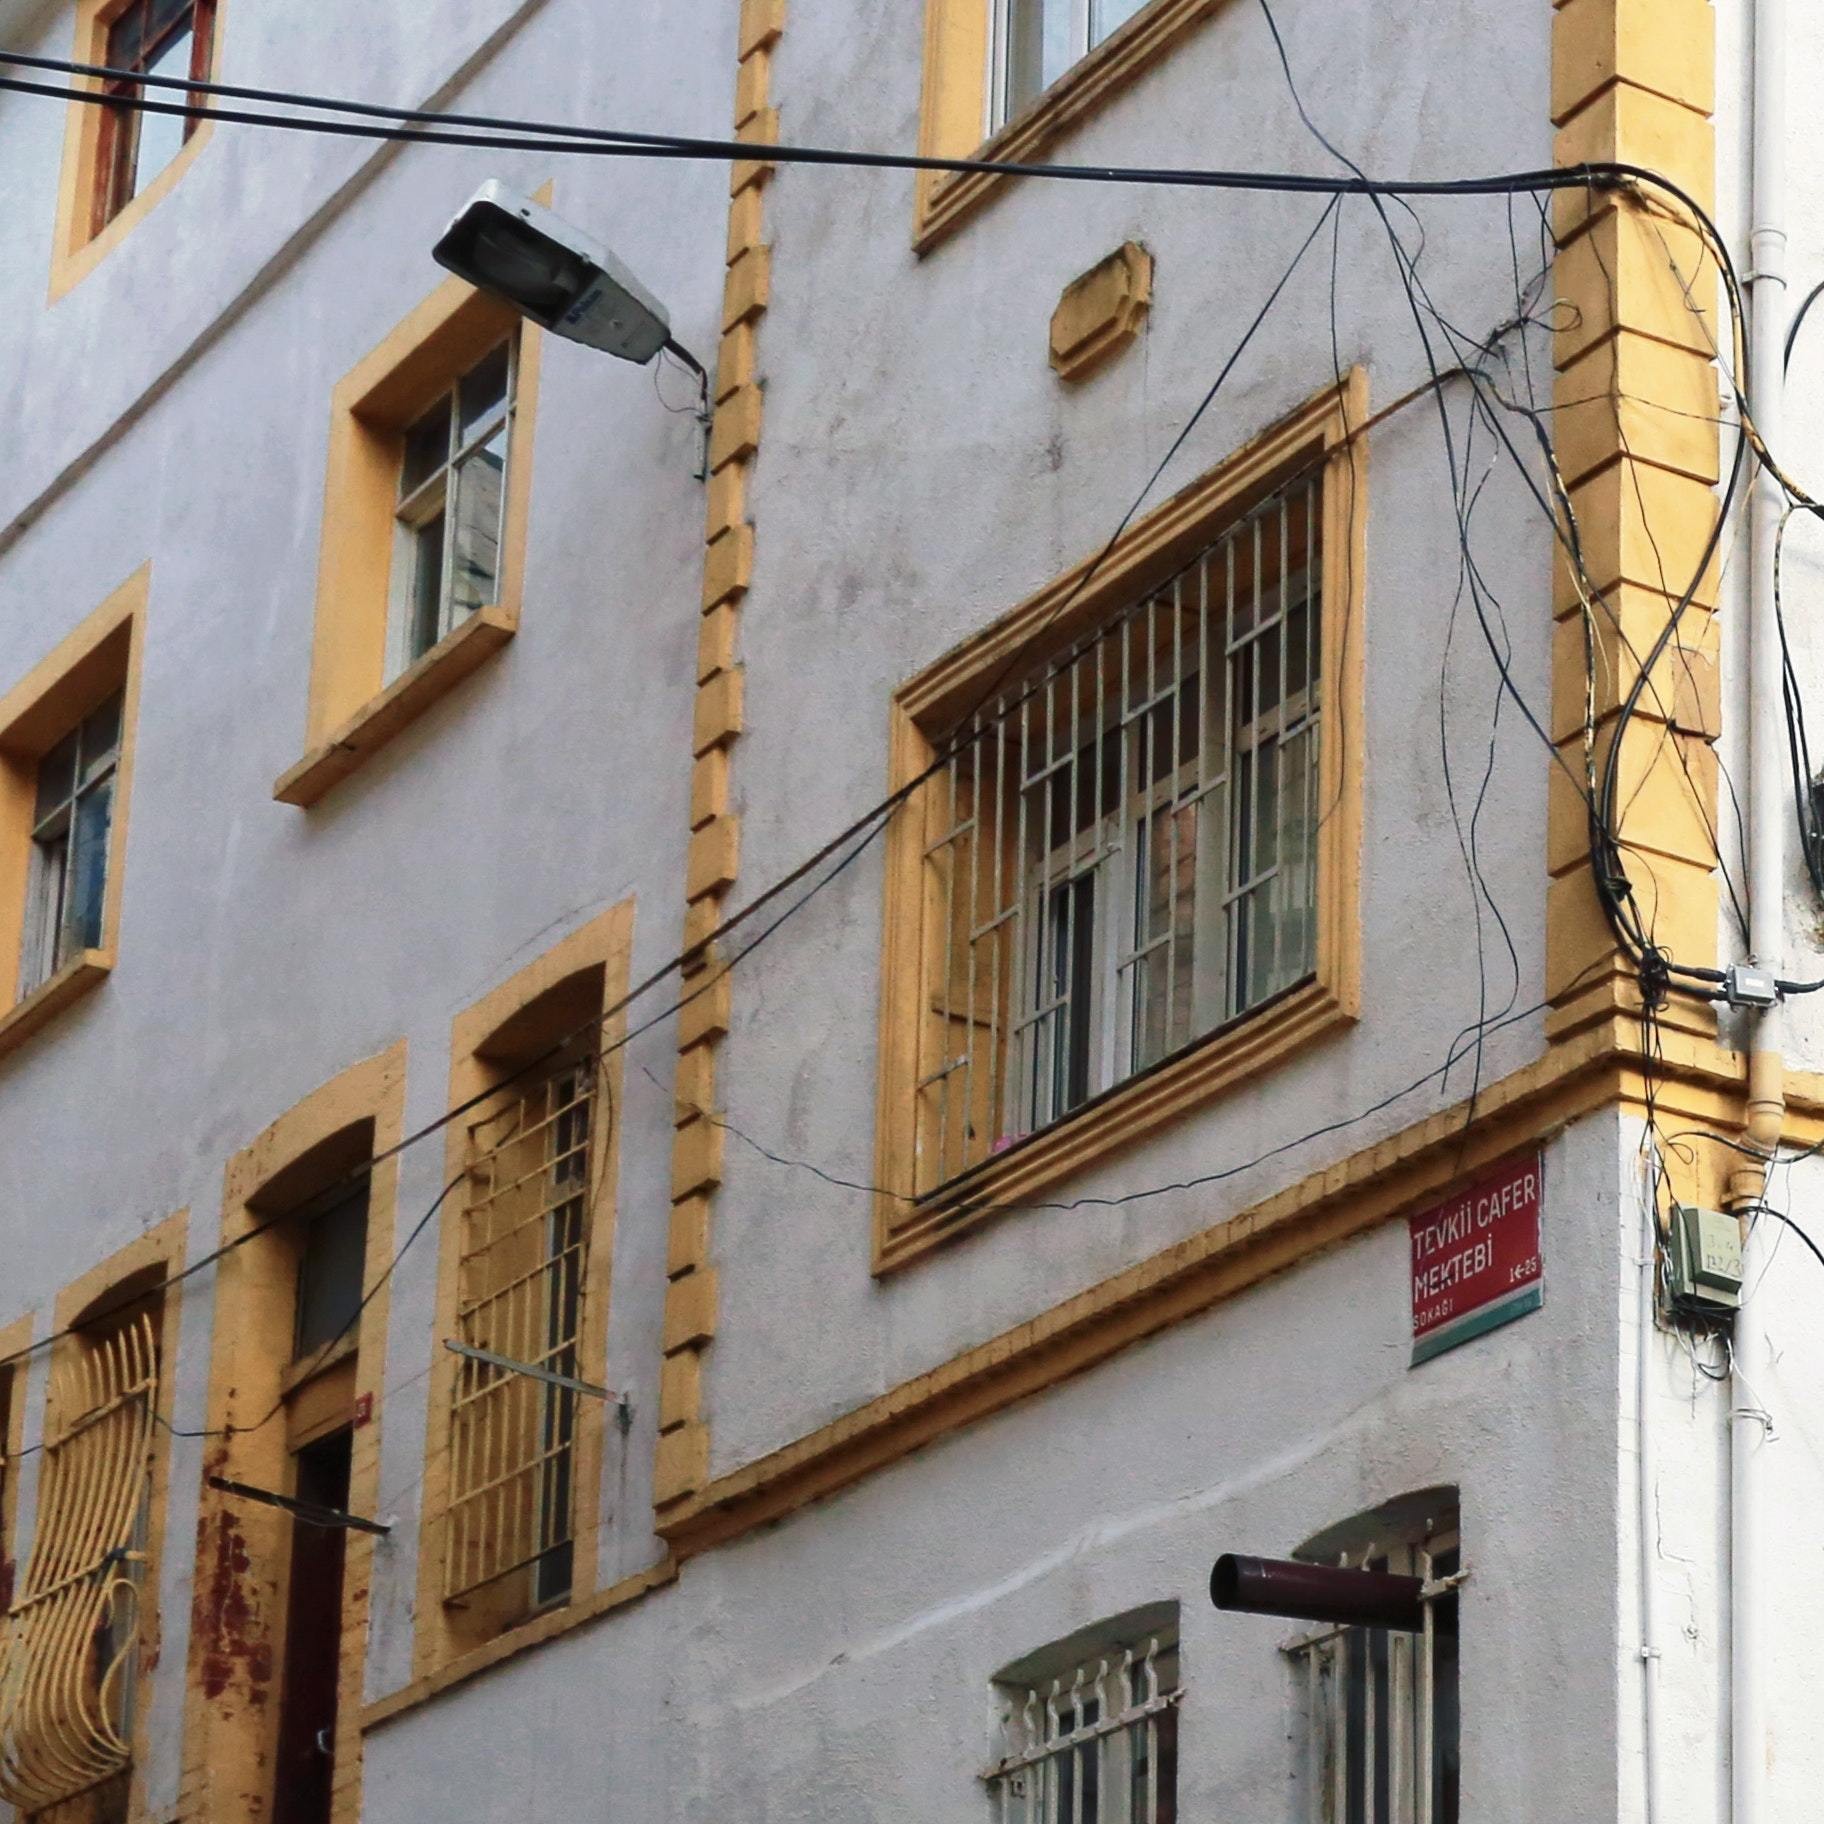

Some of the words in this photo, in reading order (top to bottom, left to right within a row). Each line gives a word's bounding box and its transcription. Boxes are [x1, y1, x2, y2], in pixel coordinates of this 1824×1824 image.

[1414, 1201, 1471, 1259] TEVKİİ
[1477, 1174, 1535, 1228] CAFER
[1414, 1234, 1492, 1302] MEKTEBİ
[1413, 1298, 1453, 1330] SOKAĞI
